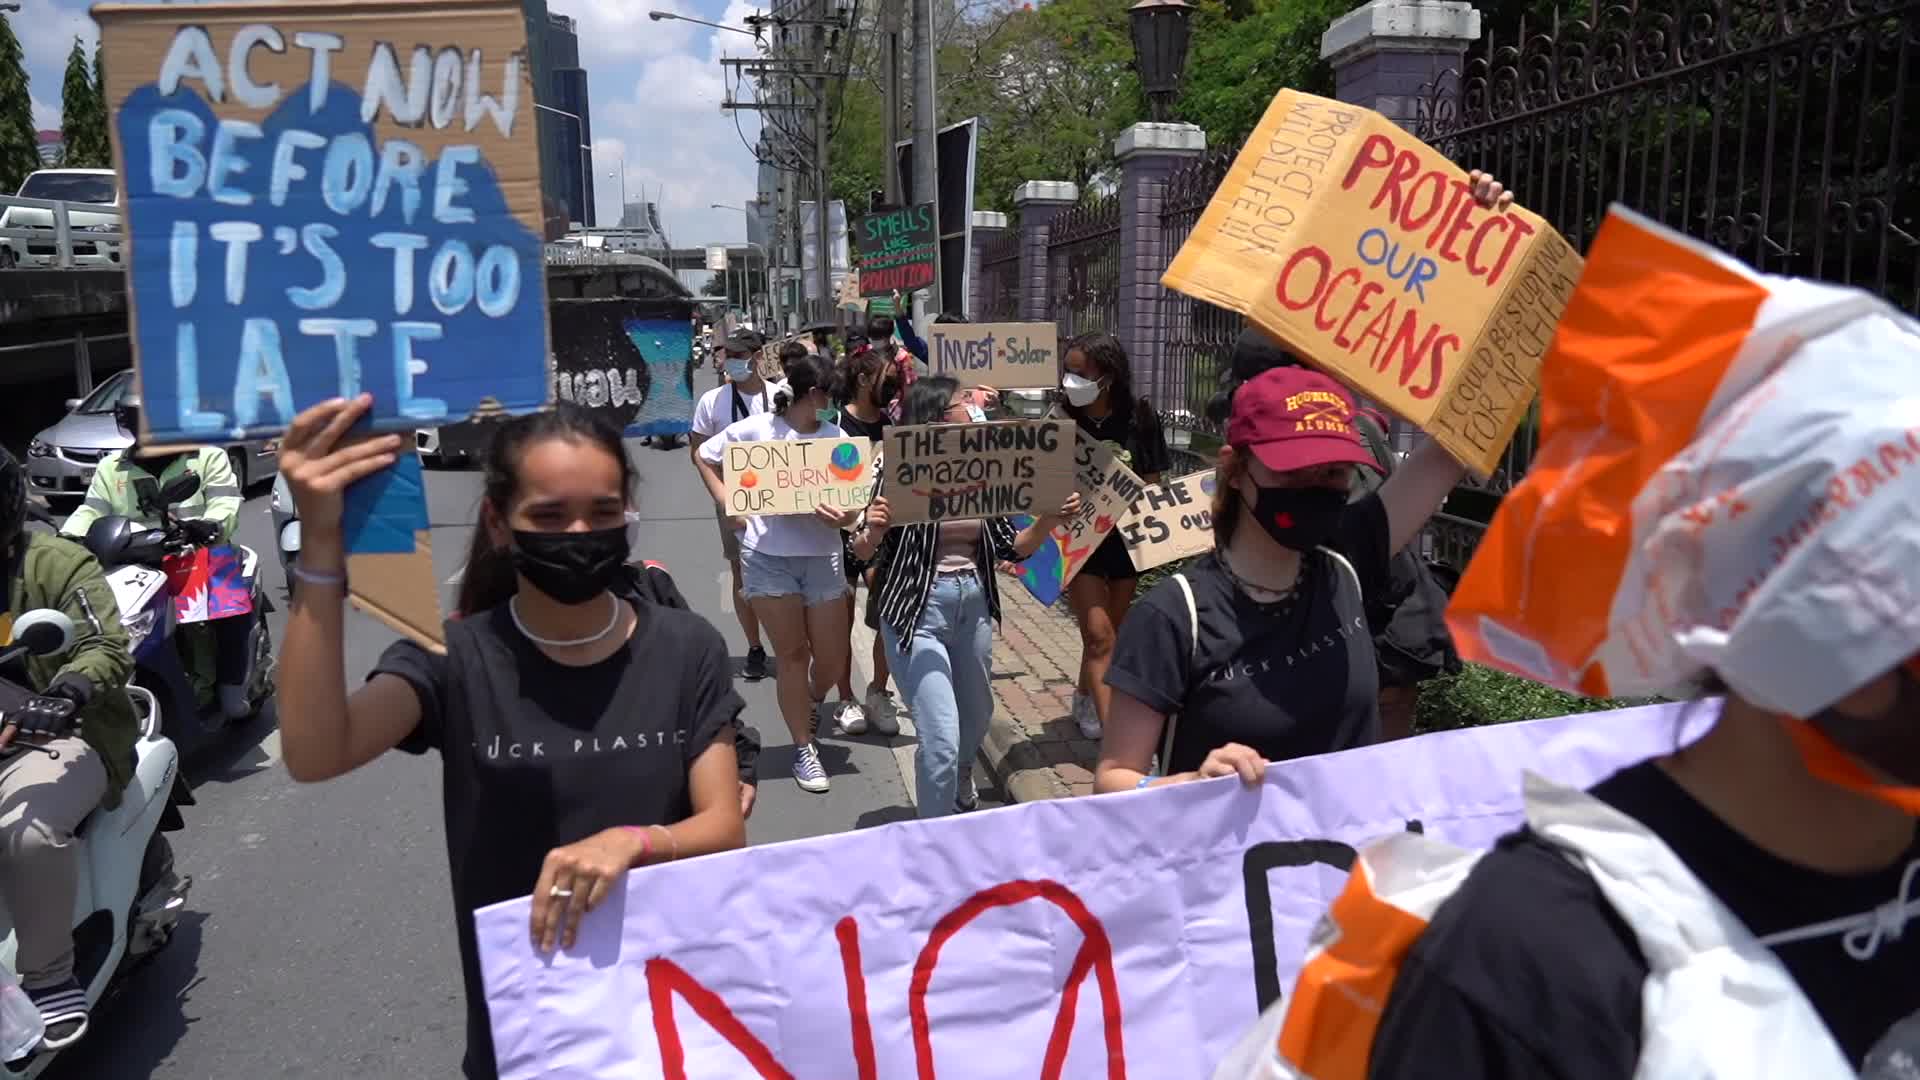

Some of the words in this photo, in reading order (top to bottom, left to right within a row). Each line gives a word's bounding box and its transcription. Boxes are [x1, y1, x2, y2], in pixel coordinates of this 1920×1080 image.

[158, 24, 343, 116] ACT
[360, 40, 521, 139] NOW
[148, 109, 482, 225] BEFORE
[1280, 109, 1356, 200] PROTECT
[864, 206, 930, 240] SMELLS
[1239, 205, 1295, 252] OUR
[1341, 133, 1534, 287] PROTECT
[169, 220, 347, 311] IT'S
[370, 233, 521, 318] TOO
[1356, 228, 1438, 303] OUR
[1275, 245, 1460, 400] OCEANS
[1451, 347, 1494, 418] COULD
[1489, 317, 1514, 350] BE
[1505, 239, 1568, 324] STUDYING
[1006, 336, 1051, 364] Solar
[175, 318, 448, 435] LATE
[893, 427, 947, 459] THE
[959, 423, 1059, 453] WRONG
[1463, 393, 1507, 453] FOR
[730, 442, 813, 471] DON'T
[896, 457, 1003, 485] amazon
[1012, 456, 1035, 478] IS
[776, 468, 829, 488] BURN
[1107, 469, 1143, 502] NOT
[733, 488, 775, 511] OUR
[928, 482, 1033, 520] BURNING
[1128, 481, 1193, 516] THE
[1122, 515, 1170, 546] IS
[472, 734, 545, 759] UCK
